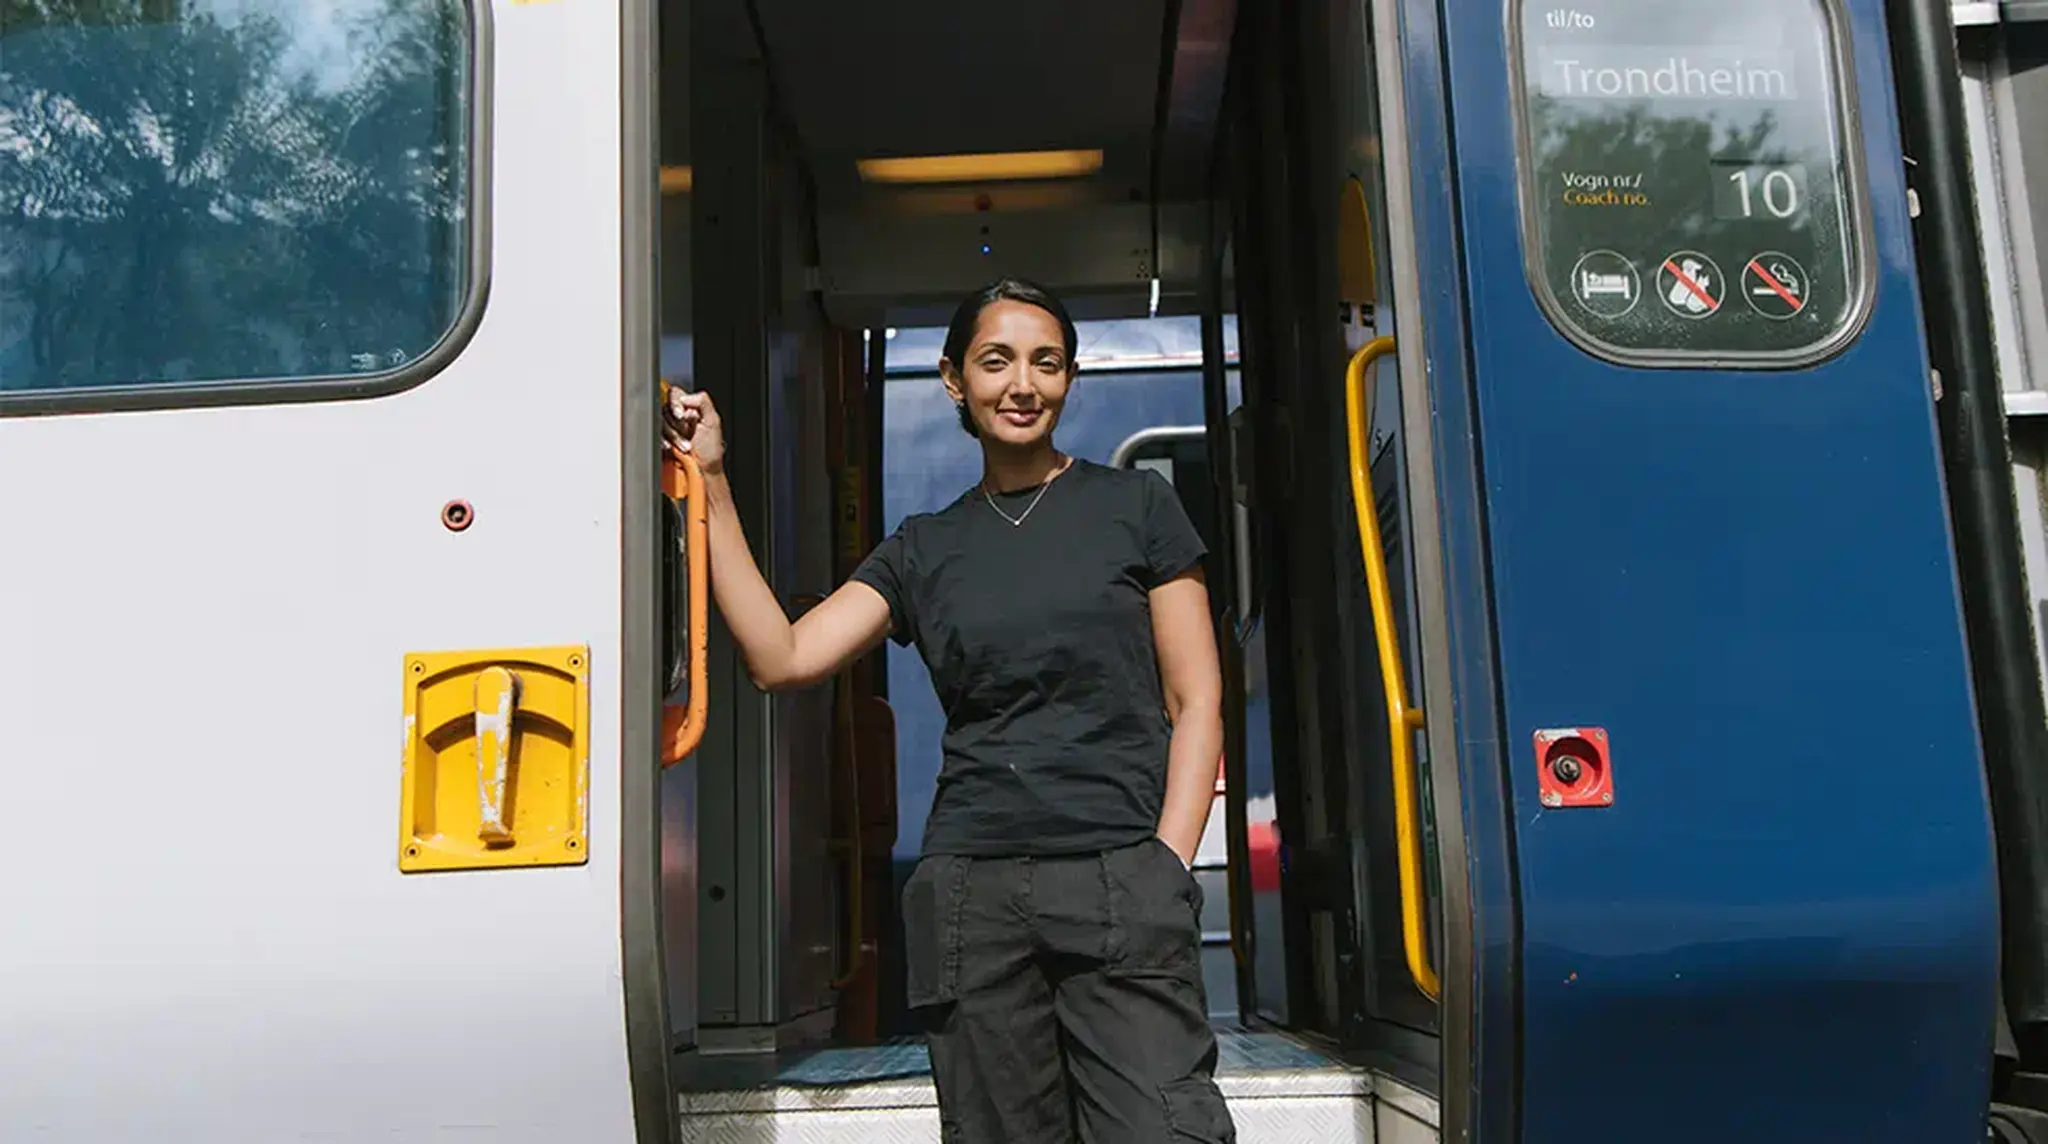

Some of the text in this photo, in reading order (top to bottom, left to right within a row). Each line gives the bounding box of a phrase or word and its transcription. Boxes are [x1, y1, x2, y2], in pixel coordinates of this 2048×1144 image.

[1546, 9, 1595, 29] til/to
[1553, 57, 1786, 96] Trondheim
[1561, 172, 1608, 191] Vogn
[1563, 188, 1620, 205] Coach
[1729, 170, 1797, 219] 10
